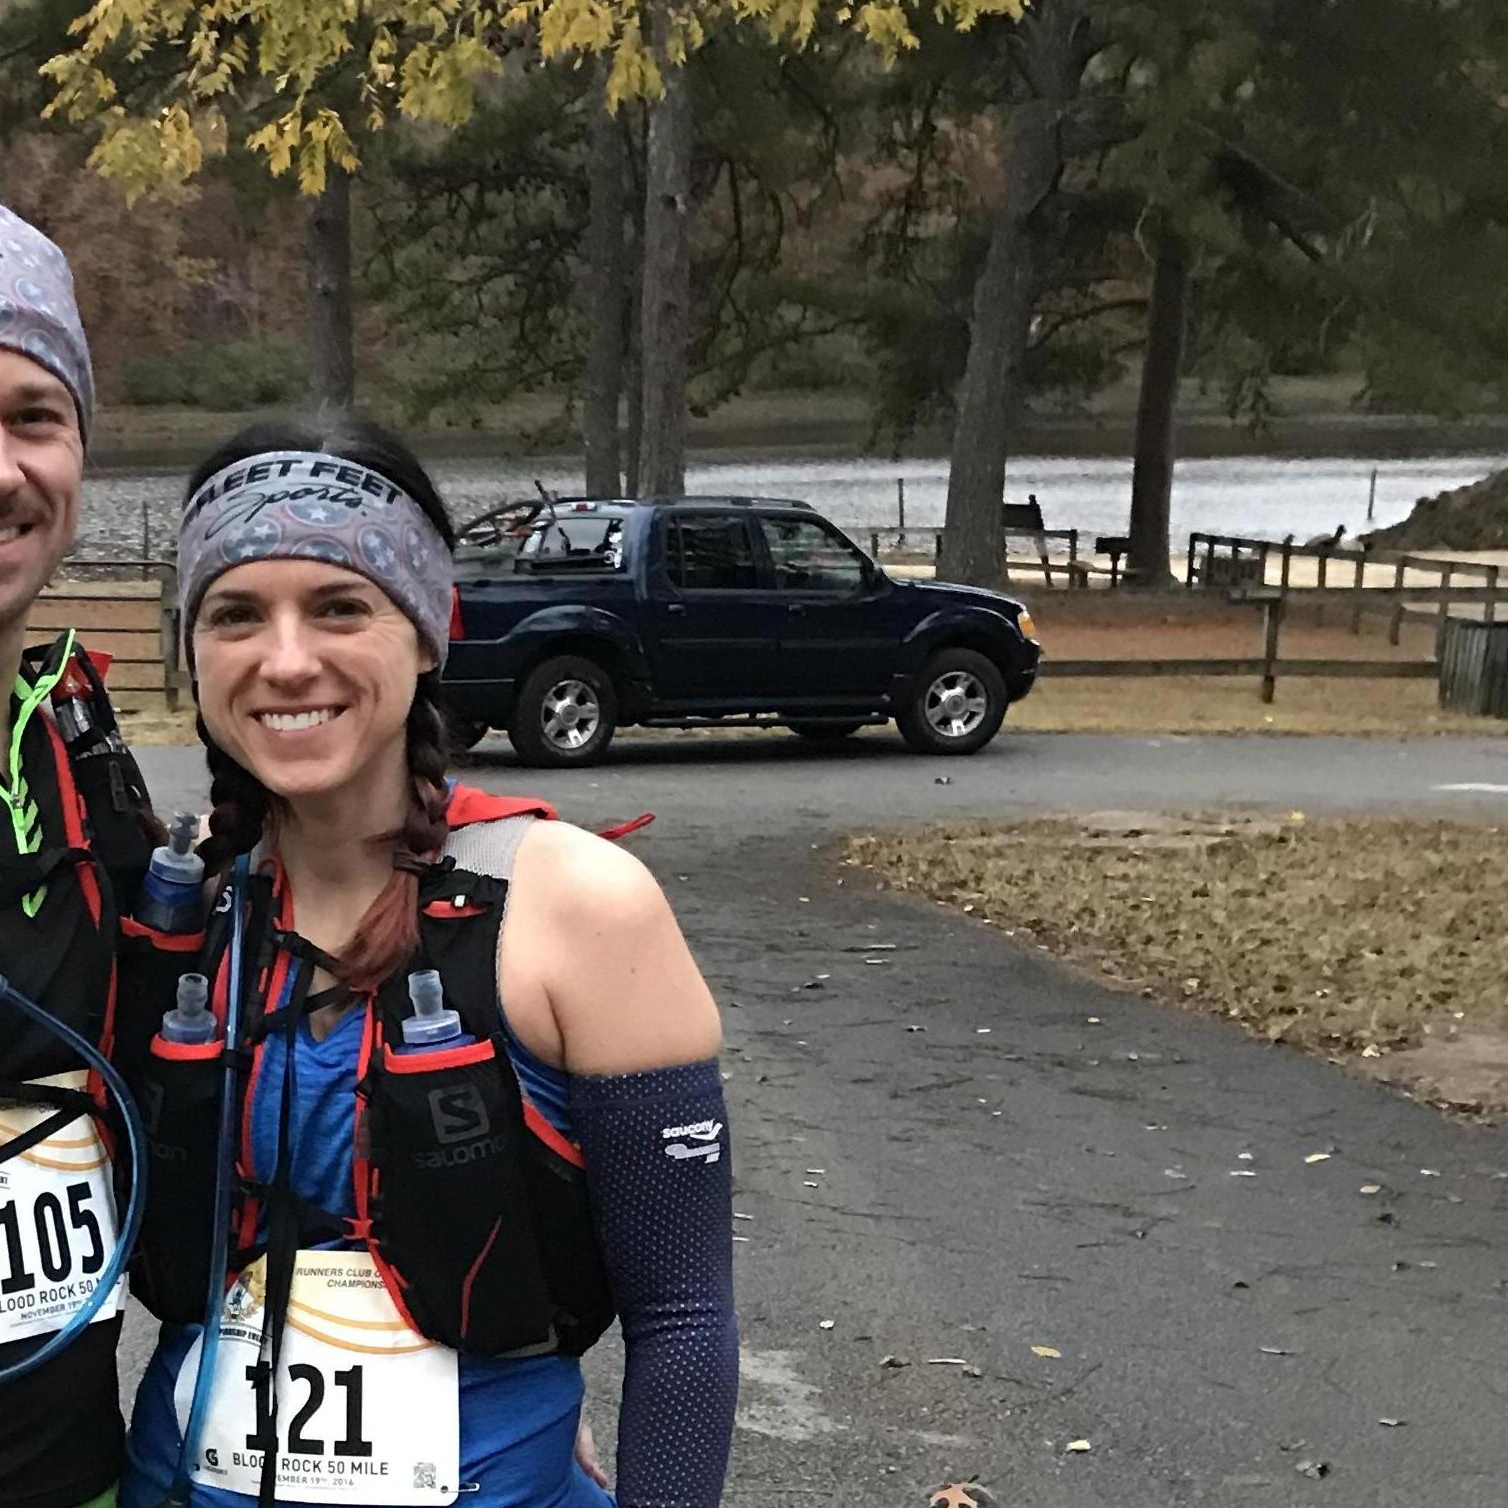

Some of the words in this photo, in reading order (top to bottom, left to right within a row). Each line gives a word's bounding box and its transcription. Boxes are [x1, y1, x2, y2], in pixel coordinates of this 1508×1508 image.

[309, 461, 403, 505] FEET
[296, 1267, 343, 1277] RUNNERS
[346, 1268, 372, 1277] CLUB
[39, 1281, 76, 1305] ROCK
[79, 1279, 94, 1295] 50
[327, 1279, 390, 1290] CHAMPIONS
[21, 1302, 66, 1321] NOVEMBER
[245, 1363, 373, 1457] 121
[282, 1458, 322, 1473] ROCK
[328, 1461, 345, 1475] 50
[351, 1462, 389, 1476] MILE
[333, 1477, 354, 1486] 2016
